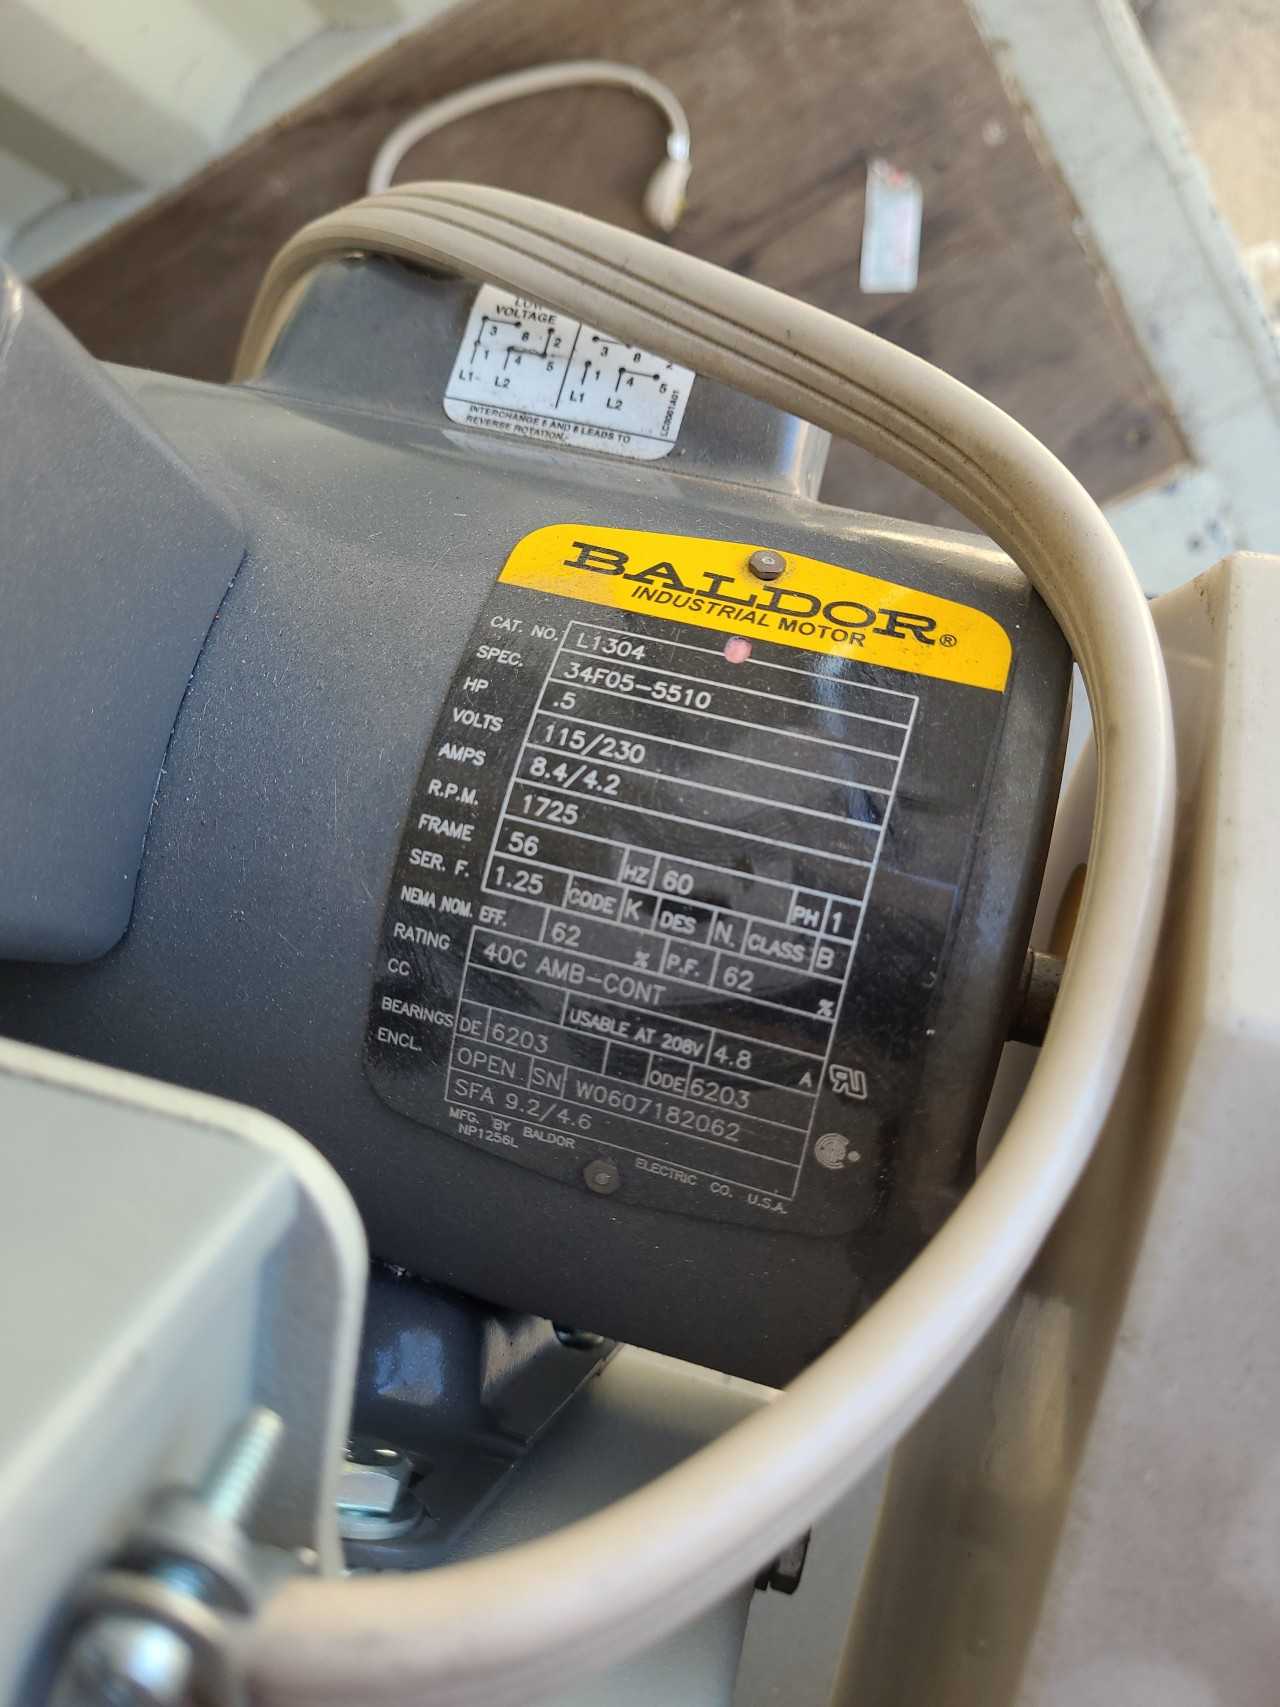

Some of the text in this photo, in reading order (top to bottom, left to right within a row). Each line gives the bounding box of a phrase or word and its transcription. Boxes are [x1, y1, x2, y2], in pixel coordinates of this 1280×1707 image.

[490, 326, 498, 336] 3
[553, 338, 562, 348] 2
[496, 305, 557, 324] VOLTAGE
[546, 362, 554, 372] 5
[600, 346, 608, 357] 3
[459, 370, 510, 389] L1 L2
[570, 390, 623, 411] L1 L2
[626, 376, 634, 388] 4
[466, 415, 512, 432] REVERSE
[469, 405, 539, 428] INTERCHANGE
[550, 420, 571, 432] AND
[580, 425, 614, 441] LEADS
[618, 433, 632, 445] TO
[490, 615, 646, 661] CAT. NO. L1304
[631, 585, 866, 648] INDUSTRIAL MOTOR
[463, 676, 576, 710] HP .5
[476, 645, 712, 710] SPEC. 34F05-5510
[452, 707, 646, 764] VOLTS 115/230
[438, 742, 621, 796] AMPS 8.4/4.2
[427, 779, 580, 825] R.P.M. 1725
[417, 813, 842, 934] FRAME 56 HZ 60 PH 1
[408, 848, 446, 872] SER.
[454, 859, 470, 877] F.
[496, 865, 544, 895] 1.25
[567, 887, 616, 914] CODE
[623, 898, 643, 921] K
[659, 910, 697, 935] DES
[747, 933, 806, 963] CLASS
[815, 946, 835, 970] B
[400, 885, 436, 910] NEMA
[439, 895, 473, 918] NOM.
[478, 905, 507, 927] EFF.
[551, 921, 582, 948] 62
[666, 952, 700, 977] P.F.
[723, 965, 754, 992] 62
[393, 921, 667, 1006] RATING 40C AMB-CONT
[387, 957, 813, 1088] CC USABLE AT 208V 4.8 A
[381, 996, 751, 1110] BEARINGS DE 6203 ODE 6203
[377, 1027, 741, 1143] ENCL. OPEN SN W0607182062
[453, 1077, 593, 1130] SFA 9.2/4.6
[458, 1122, 520, 1149] NP1256L
[448, 1106, 789, 1215] MFG. BY BALDOR ELECTRIC CO. U.S.A.
